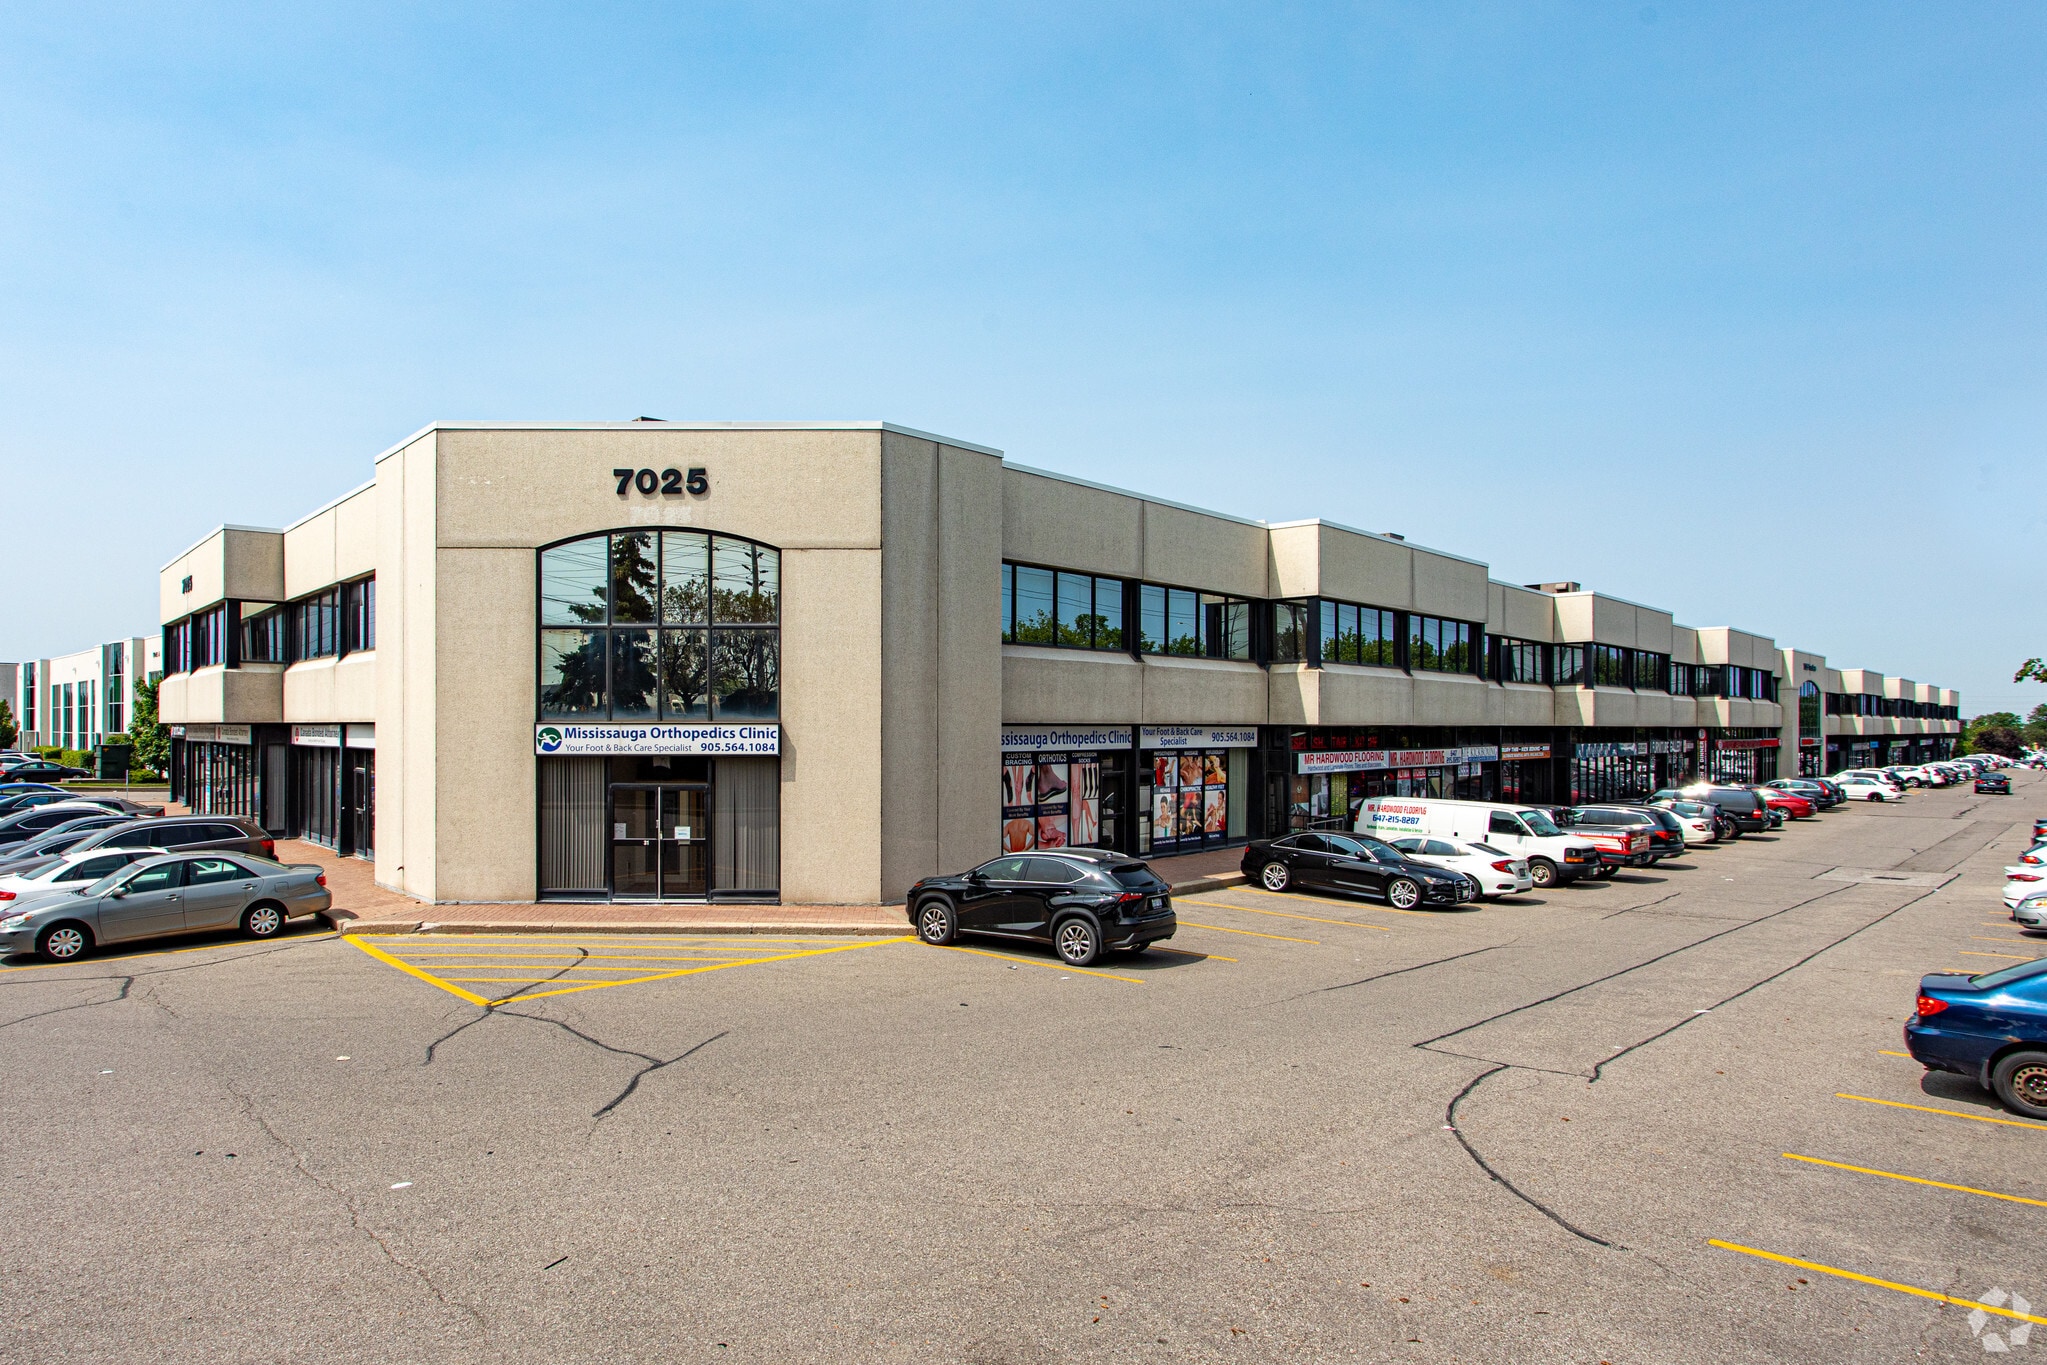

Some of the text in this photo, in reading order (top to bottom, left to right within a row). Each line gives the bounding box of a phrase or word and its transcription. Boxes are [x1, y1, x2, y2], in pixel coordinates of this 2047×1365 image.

[613, 468, 708, 495] 7025
[565, 727, 777, 741] Mississauga Orthopedics Clinic
[1142, 728, 1155, 736] Your
[1156, 728, 1170, 736] Foot
[1190, 727, 1203, 735] Care
[1001, 730, 1132, 748] ssissauga Orthopedics Clinic
[1160, 737, 1187, 747] Specialist
[1211, 732, 1255, 742] 905.564.1084
[566, 743, 776, 753] Your Foot & Back Care Specialist 905.564.1084
[1038, 754, 1067, 763] ORTHOTICS
[1304, 751, 1384, 764] MR HARDWOOD FLOORING
[1400, 751, 1424, 766] HARDWOOD
[1425, 750, 1444, 765] FLOORING
[1377, 805, 1403, 813] HARDWOOD
[1403, 806, 1427, 815] FLOORING
